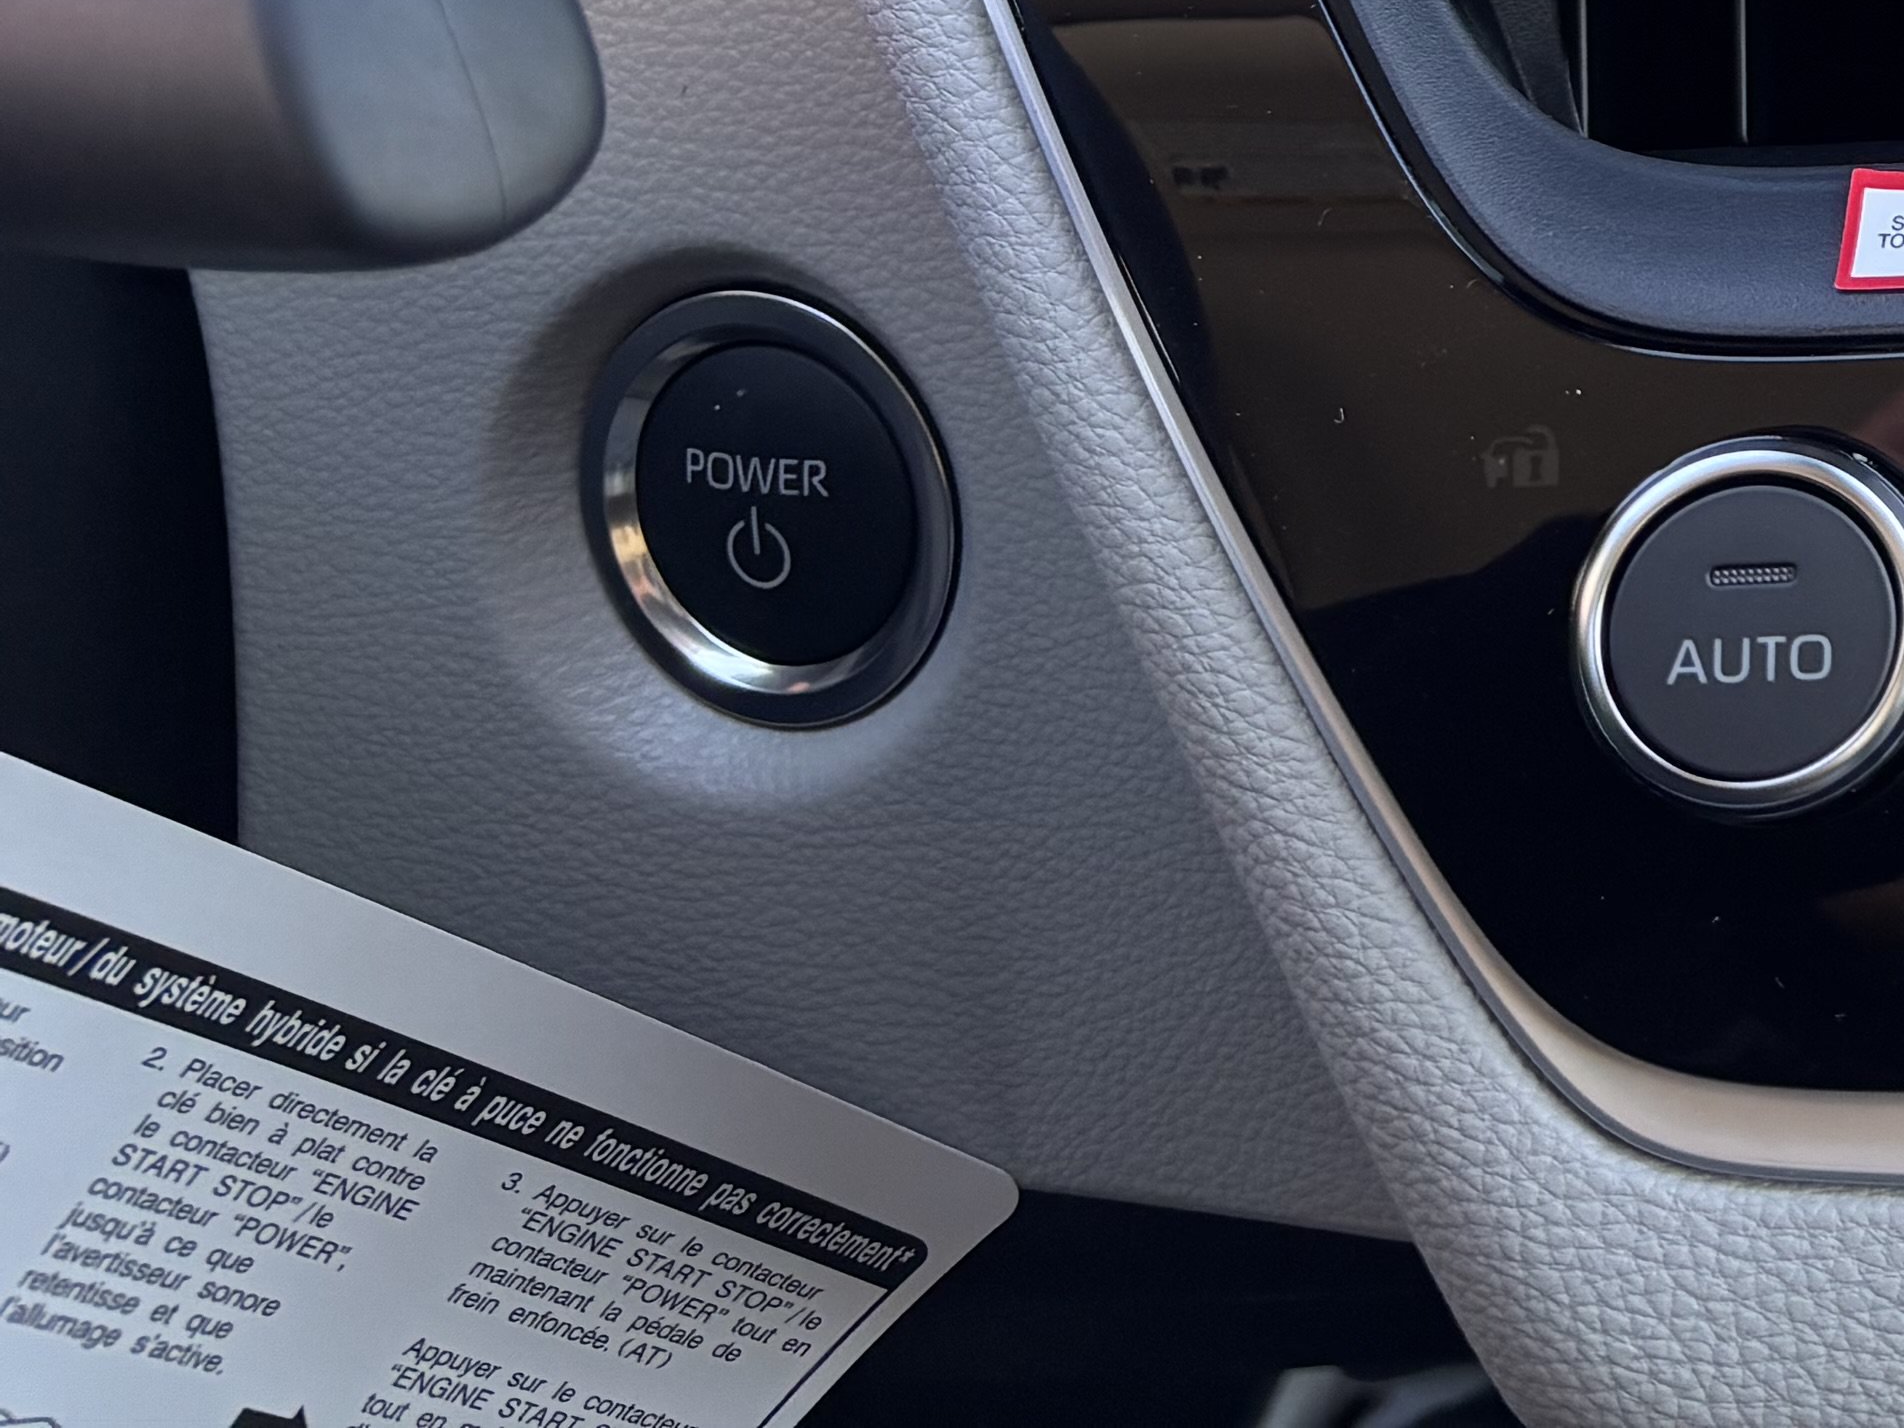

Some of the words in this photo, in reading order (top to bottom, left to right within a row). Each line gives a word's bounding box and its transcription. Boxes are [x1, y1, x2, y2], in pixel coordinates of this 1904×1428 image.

[685, 447, 830, 498] POWER
[1665, 631, 1835, 685] AUTO
[132, 966, 247, 1025] système
[245, 1000, 347, 1061] hybride
[344, 1042, 387, 1074] si
[376, 1048, 412, 1086] la
[410, 1066, 465, 1101] clé
[454, 1076, 487, 1112] à
[141, 1046, 169, 1072] 2.
[179, 1057, 264, 1101] Placer
[268, 1090, 409, 1151] directement
[412, 1138, 439, 1164] la
[470, 1095, 547, 1135] puce
[544, 1119, 585, 1150] ne
[111, 1142, 210, 1187] START
[132, 1113, 161, 1139] le
[168, 1129, 298, 1182] contacteur
[311, 1168, 422, 1222] “ENGINE
[157, 1090, 202, 1114] clé
[204, 1101, 261, 1135] bien
[267, 1121, 290, 1146] à
[290, 1135, 346, 1164] plat
[351, 1154, 426, 1191] contre
[583, 1128, 710, 1197] fonctionne
[87, 1176, 220, 1227] contacteur
[698, 1186, 757, 1216] pas
[163, 1235, 198, 1258] ce
[205, 1248, 255, 1275] que
[500, 1171, 523, 1194] 3.
[532, 1184, 631, 1230] Appuyer
[634, 1222, 677, 1246] sur
[680, 1235, 705, 1258] le
[711, 1251, 824, 1301] contacteur
[519, 1206, 624, 1259] “ENGINE
[625, 1247, 714, 1289] START
[17, 1269, 142, 1315] retentisse
[148, 1303, 180, 1325] et
[184, 1313, 234, 1339] que
[40, 1232, 193, 1291] l'avertisseur
[196, 1280, 282, 1317] sonore
[490, 1235, 611, 1286] contacteur
[730, 1316, 779, 1346] tout
[781, 1336, 813, 1359] en
[446, 1283, 501, 1316] frein
[617, 1338, 673, 1370] (AT)
[467, 1260, 596, 1315] maintenant
[598, 1299, 624, 1324] la
[625, 1316, 705, 1350] pédale
[711, 1340, 743, 1364] de
[390, 1362, 496, 1411] “ENGINE
[497, 1397, 586, 1428] START
[401, 1336, 503, 1381] Appuyer
[506, 1370, 550, 1394] sur
[553, 1381, 577, 1404] le
[360, 1392, 411, 1423] tout
[415, 1410, 448, 1428] en
